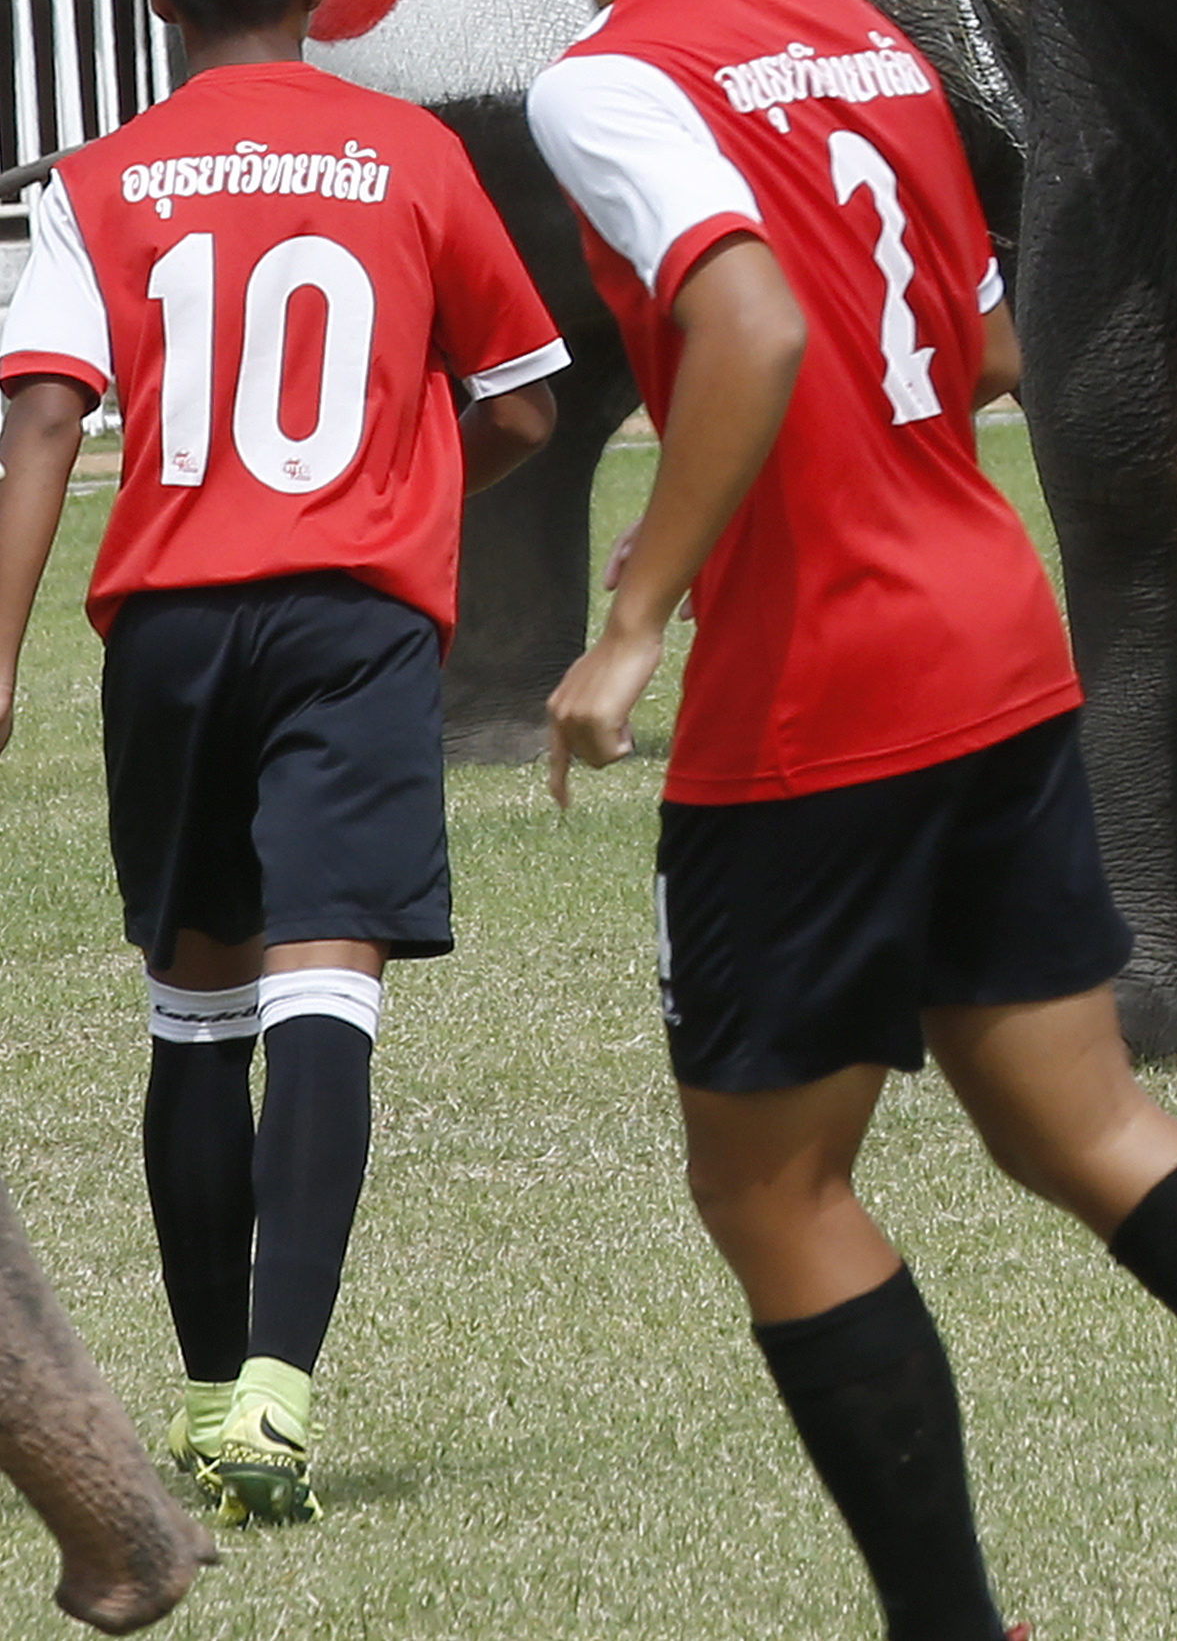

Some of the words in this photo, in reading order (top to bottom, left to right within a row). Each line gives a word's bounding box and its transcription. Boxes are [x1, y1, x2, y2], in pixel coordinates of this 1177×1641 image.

[121, 140, 391, 220] อยุธยาวิทยาลัย
[147, 232, 376, 495] 10
